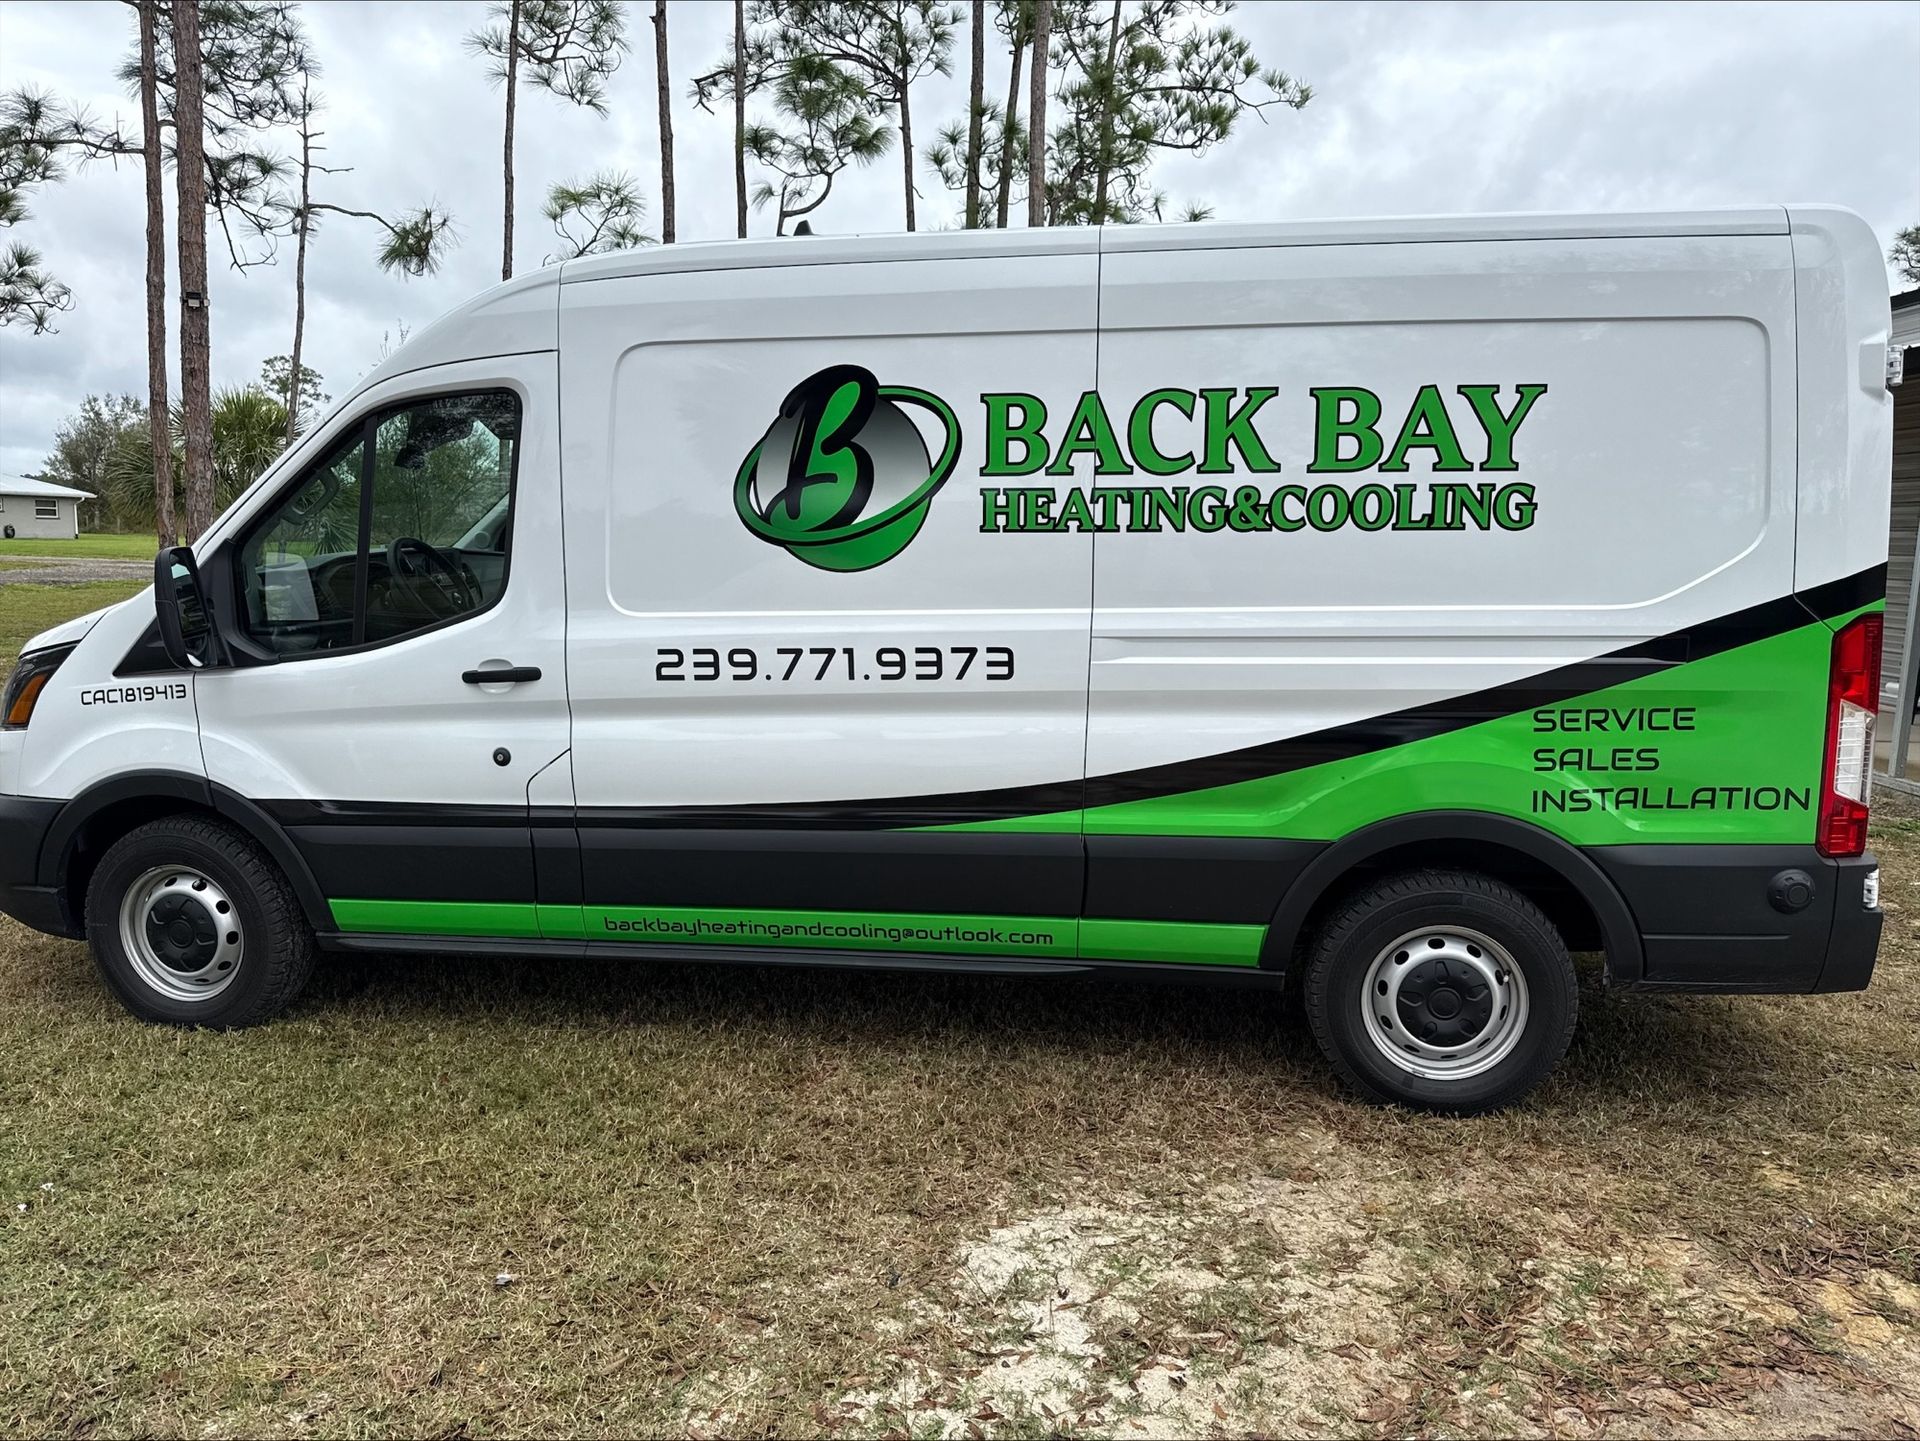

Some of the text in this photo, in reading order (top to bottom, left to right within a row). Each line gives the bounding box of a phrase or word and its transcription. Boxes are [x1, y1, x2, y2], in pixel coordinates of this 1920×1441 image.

[979, 384, 1548, 476] BACK BAY
[764, 364, 881, 534] B
[979, 483, 1538, 533] HEATING&COOLING
[656, 647, 1015, 681] 239.771.9373
[80, 684, 187, 705] CAC1819413
[1533, 707, 1696, 732] SERVICE
[1533, 748, 1660, 772] SALES
[1532, 787, 1811, 812] INSTALLATION
[604, 917, 1054, 945] backbayheatingandcooling@outlook.com
